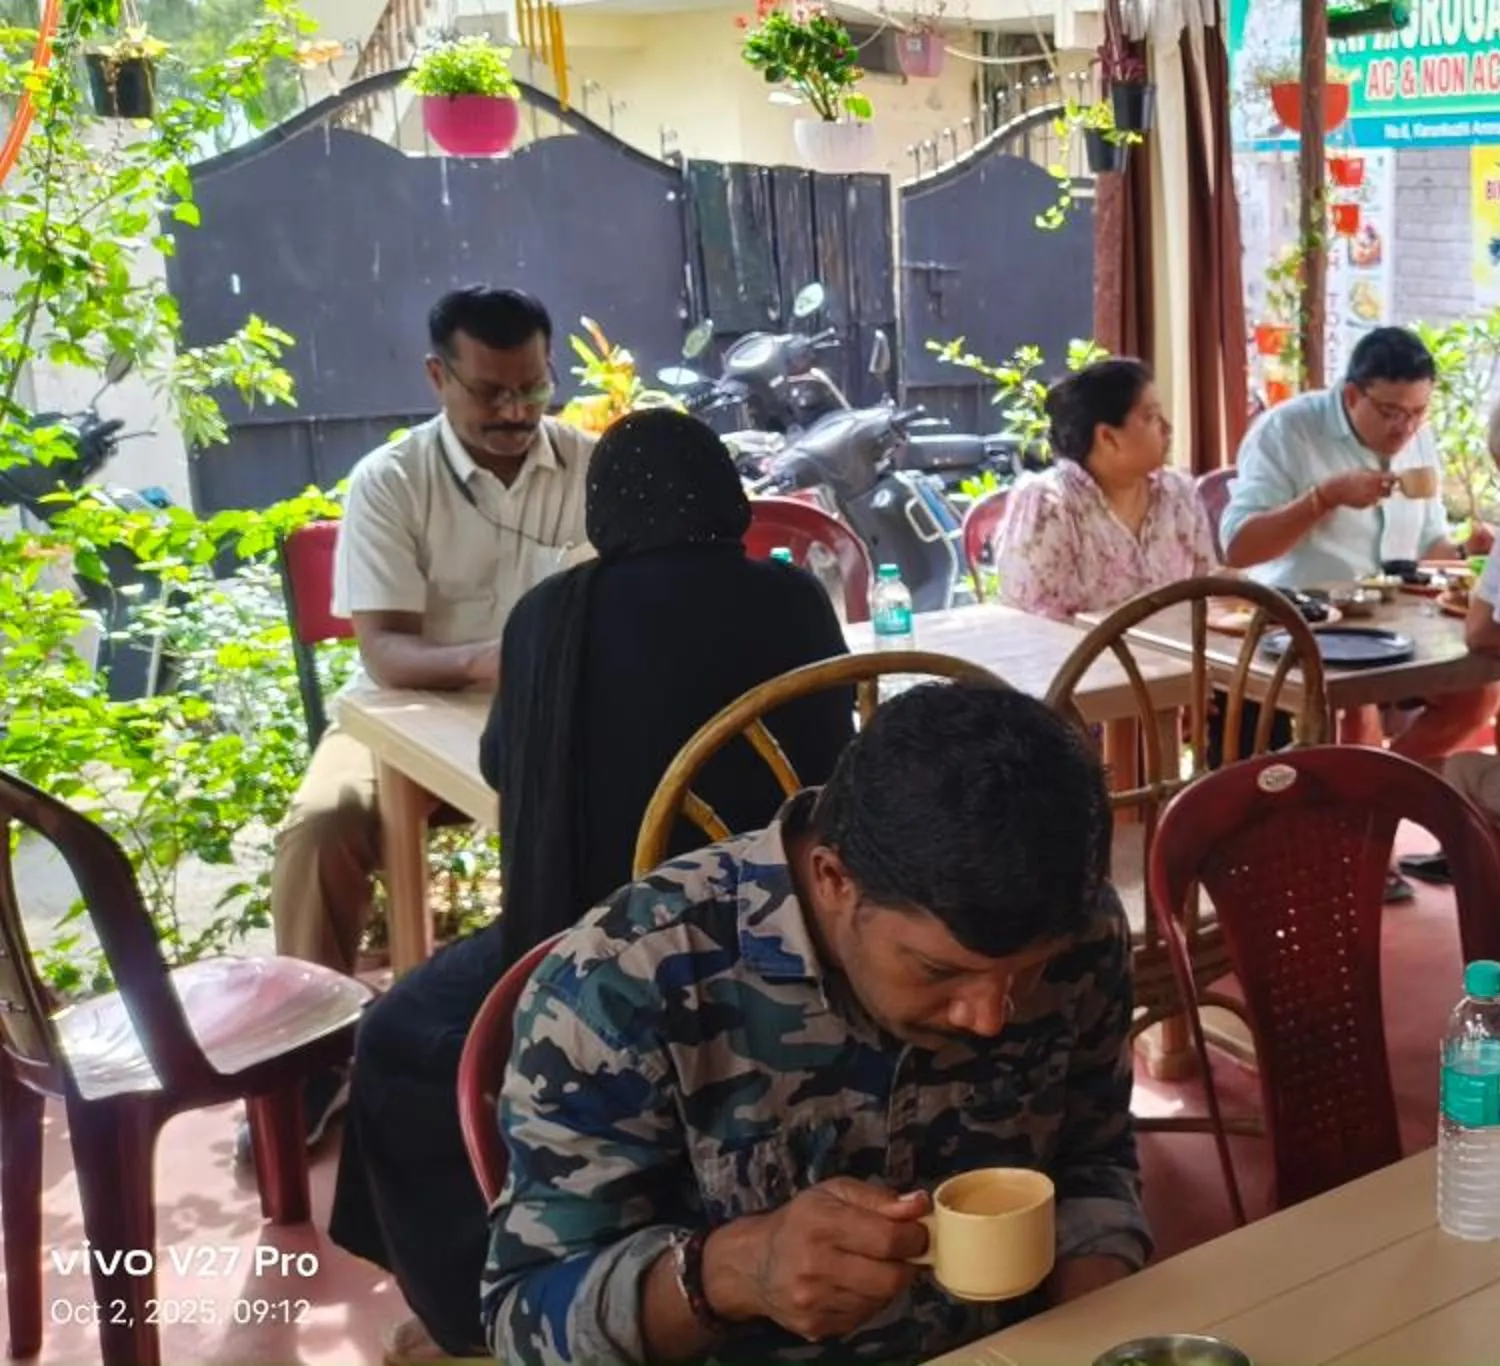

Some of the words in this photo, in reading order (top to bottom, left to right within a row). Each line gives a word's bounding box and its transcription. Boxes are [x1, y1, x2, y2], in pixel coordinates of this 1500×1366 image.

[1369, 60, 1396, 97] AC
[1402, 60, 1415, 93] &
[1423, 56, 1466, 95] NON
[1473, 53, 1500, 92] AC
